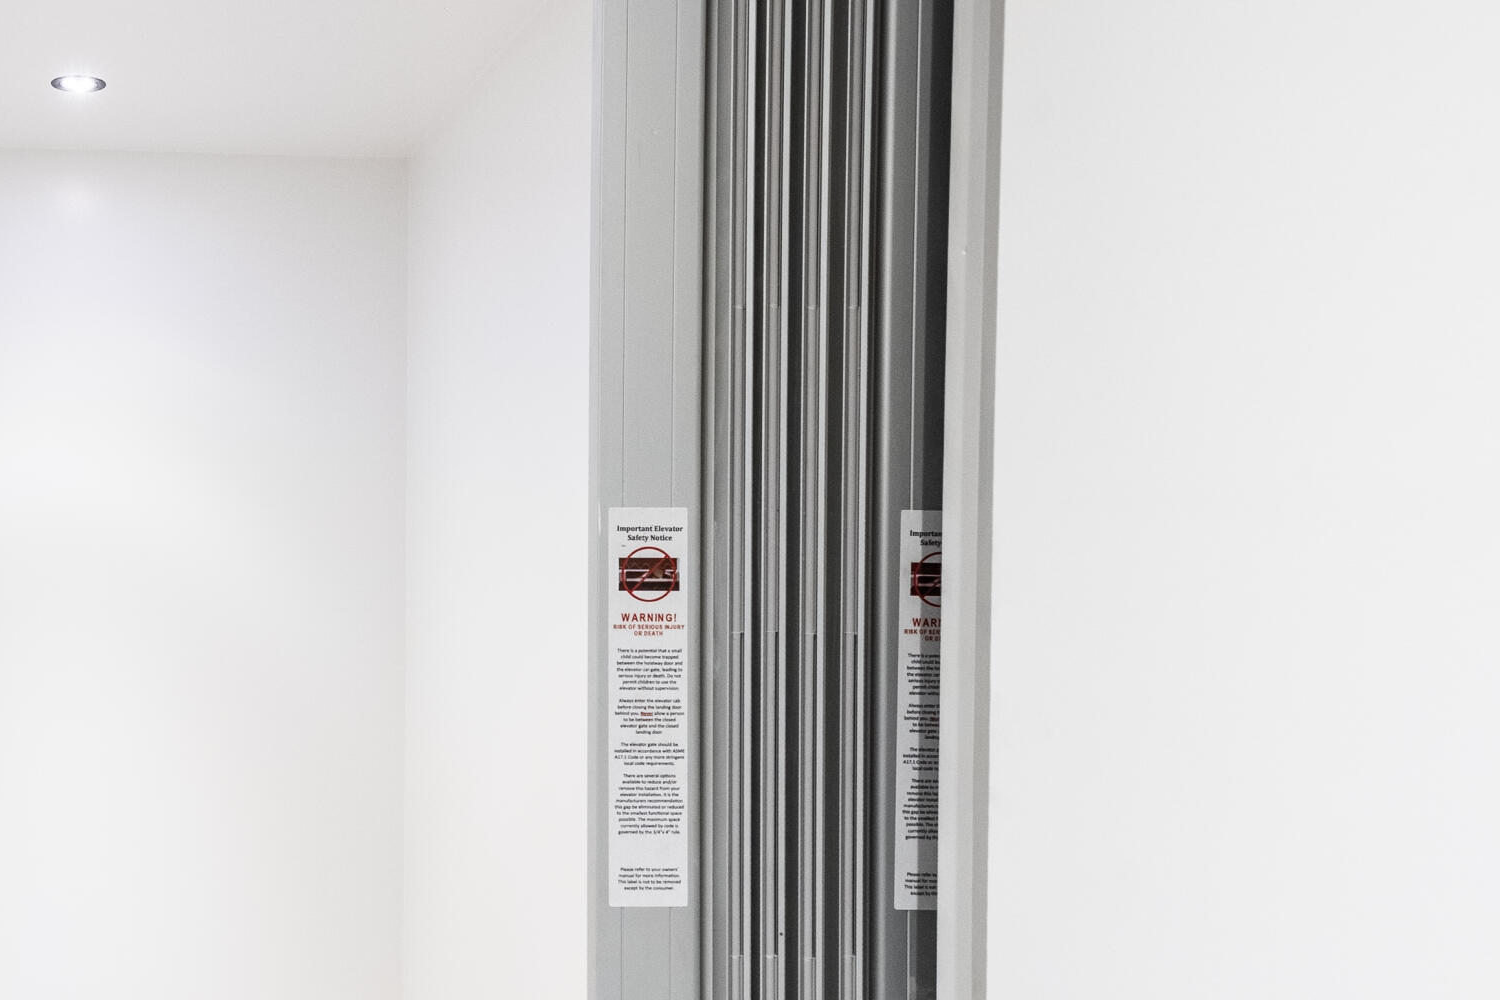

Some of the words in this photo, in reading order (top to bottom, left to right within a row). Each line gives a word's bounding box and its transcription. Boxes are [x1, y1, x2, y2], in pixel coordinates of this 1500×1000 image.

[617, 525, 653, 533] Important
[627, 535, 649, 543] Safety
[621, 613, 677, 622] WARNING!
